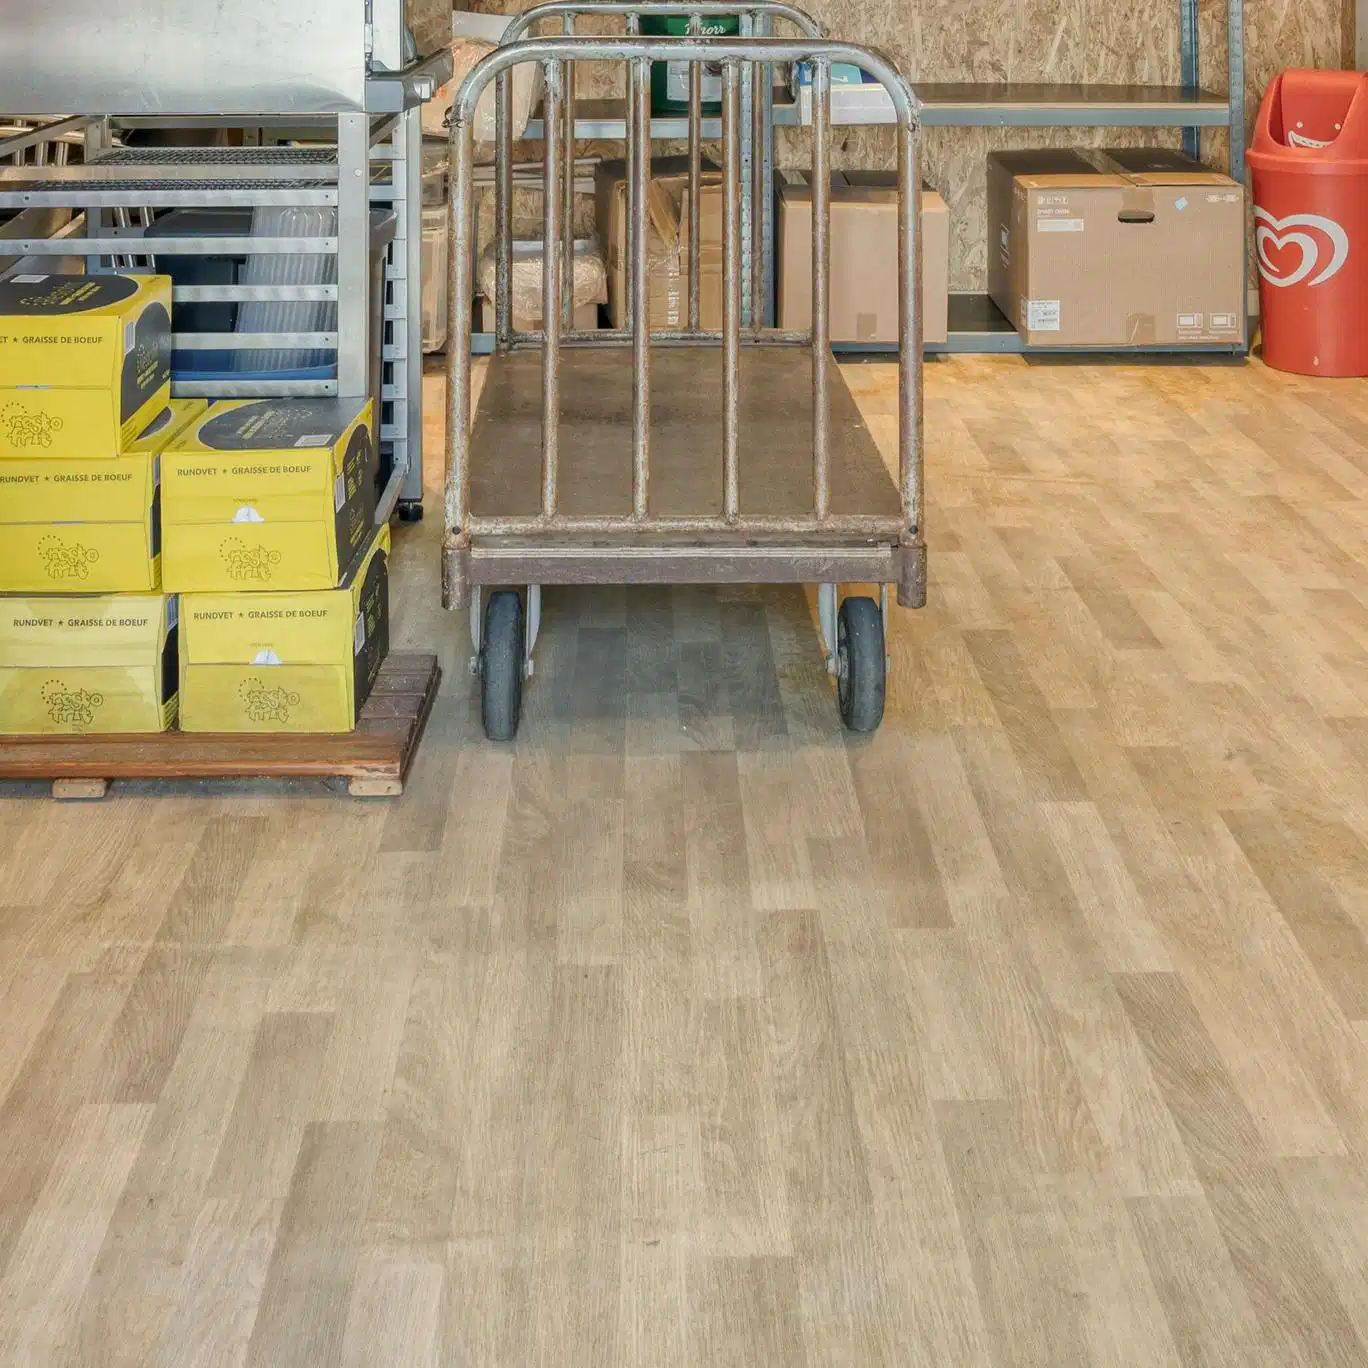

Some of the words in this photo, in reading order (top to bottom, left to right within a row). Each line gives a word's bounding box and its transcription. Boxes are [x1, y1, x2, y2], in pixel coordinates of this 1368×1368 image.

[684, 22, 727, 35] orr
[22, 336, 58, 344] GRAISSE
[60, 336, 72, 344] DE
[74, 336, 103, 344] BOEUF
[177, 468, 217, 477] RUNDVET
[231, 466, 268, 475] GRAISSE
[269, 466, 281, 474] DE
[282, 465, 313, 473] BOEUF
[0, 475, 39, 484] RUNDVET
[53, 474, 89, 482] GRAISSE
[91, 474, 102, 482] DE
[104, 473, 133, 481] BOEUF
[193, 611, 234, 620] RUNDVET
[248, 610, 283, 619] GRAISSE
[285, 610, 297, 618] DE
[299, 609, 328, 618] BOEUF
[13, 619, 53, 627] RUNDVET
[67, 618, 104, 627] GRAISSE
[106, 619, 117, 627] DE
[119, 618, 148, 627] BOEUF
